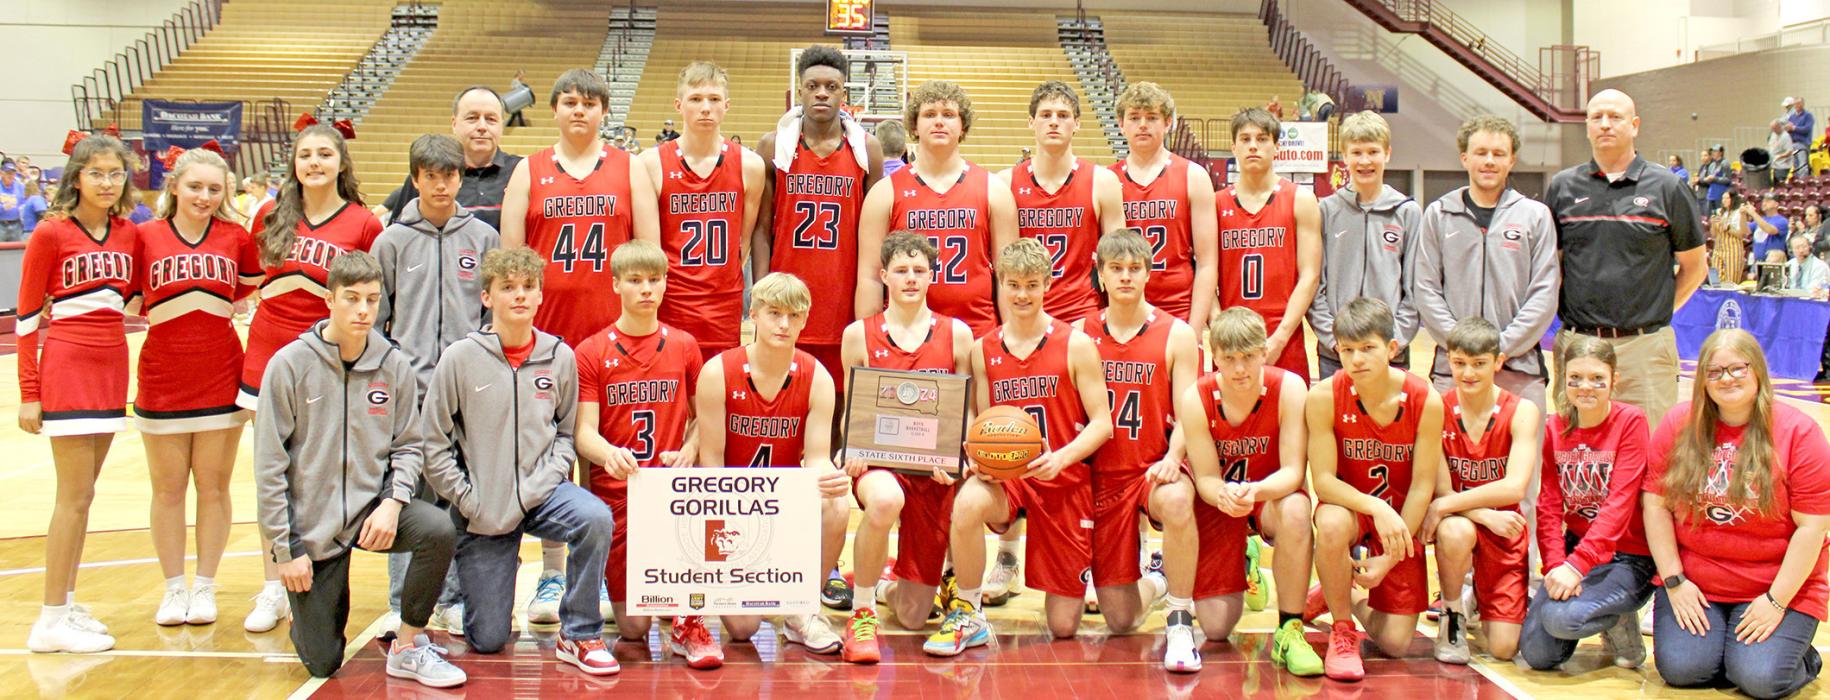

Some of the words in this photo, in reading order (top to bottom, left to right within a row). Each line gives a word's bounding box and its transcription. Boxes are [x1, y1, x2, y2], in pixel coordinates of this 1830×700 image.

[838, 4, 864, 27] 35
[786, 174, 855, 197] GREGORY
[544, 195, 616, 218] GREGORY
[670, 192, 737, 214] GREGORY
[1123, 200, 1178, 221] REGORY
[793, 200, 841, 249] 23
[907, 208, 976, 230] GREGORY
[1018, 207, 1085, 228] GREGORY
[552, 222, 608, 273] 44
[680, 219, 728, 267] 20
[1221, 227, 1287, 251] GREGORY
[1241, 253, 1263, 300] 0
[1101, 360, 1156, 385] EGORY
[606, 380, 679, 407] GREGORY
[993, 375, 1059, 402] GREGORY
[631, 410, 656, 461] 3
[729, 413, 800, 438] GREGORY
[859, 450, 888, 459] STATE
[889, 453, 916, 462] SIXTH
[918, 456, 946, 464] PLACE
[1343, 438, 1414, 462] GREGORY
[1448, 456, 1508, 482] REGORY
[671, 476, 780, 493] GREGORY
[670, 499, 780, 516] GORILLAS
[644, 568, 723, 584] Student
[730, 567, 803, 584] Section
[641, 594, 674, 603] Billion
